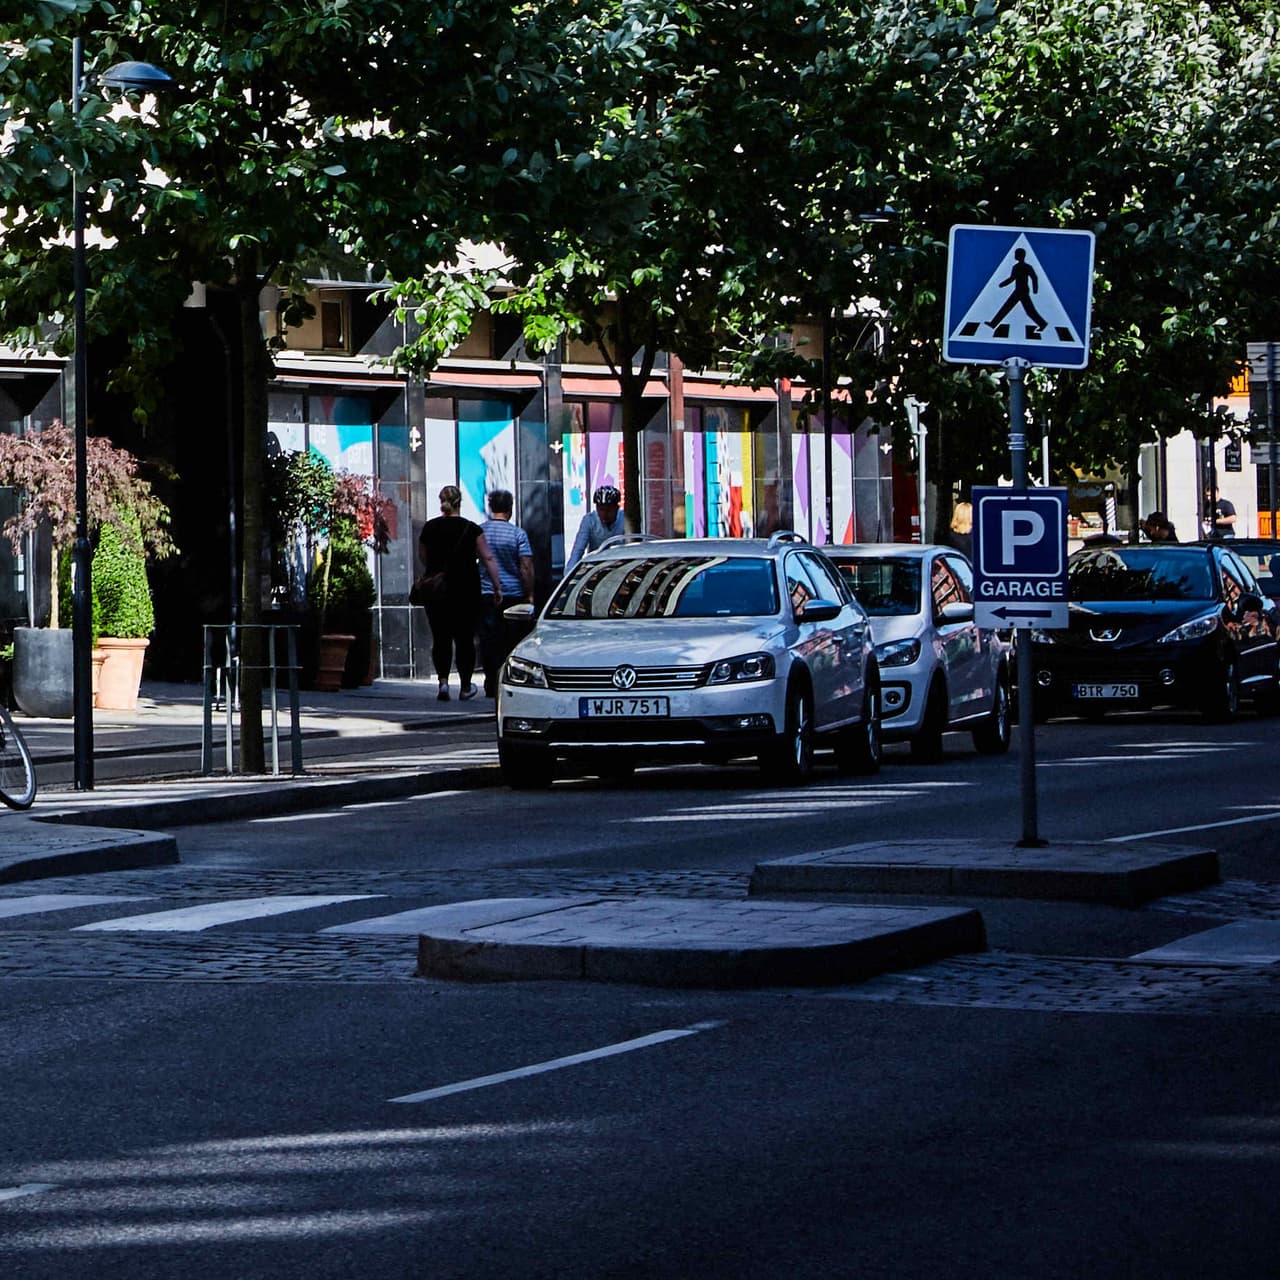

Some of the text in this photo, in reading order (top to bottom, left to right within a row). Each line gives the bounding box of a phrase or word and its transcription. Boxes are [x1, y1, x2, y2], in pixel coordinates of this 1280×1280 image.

[1001, 510, 1045, 566] P
[980, 581, 1064, 597] GARAGE
[1079, 685, 1137, 697] BTR 750
[593, 699, 660, 715] WJR 751
